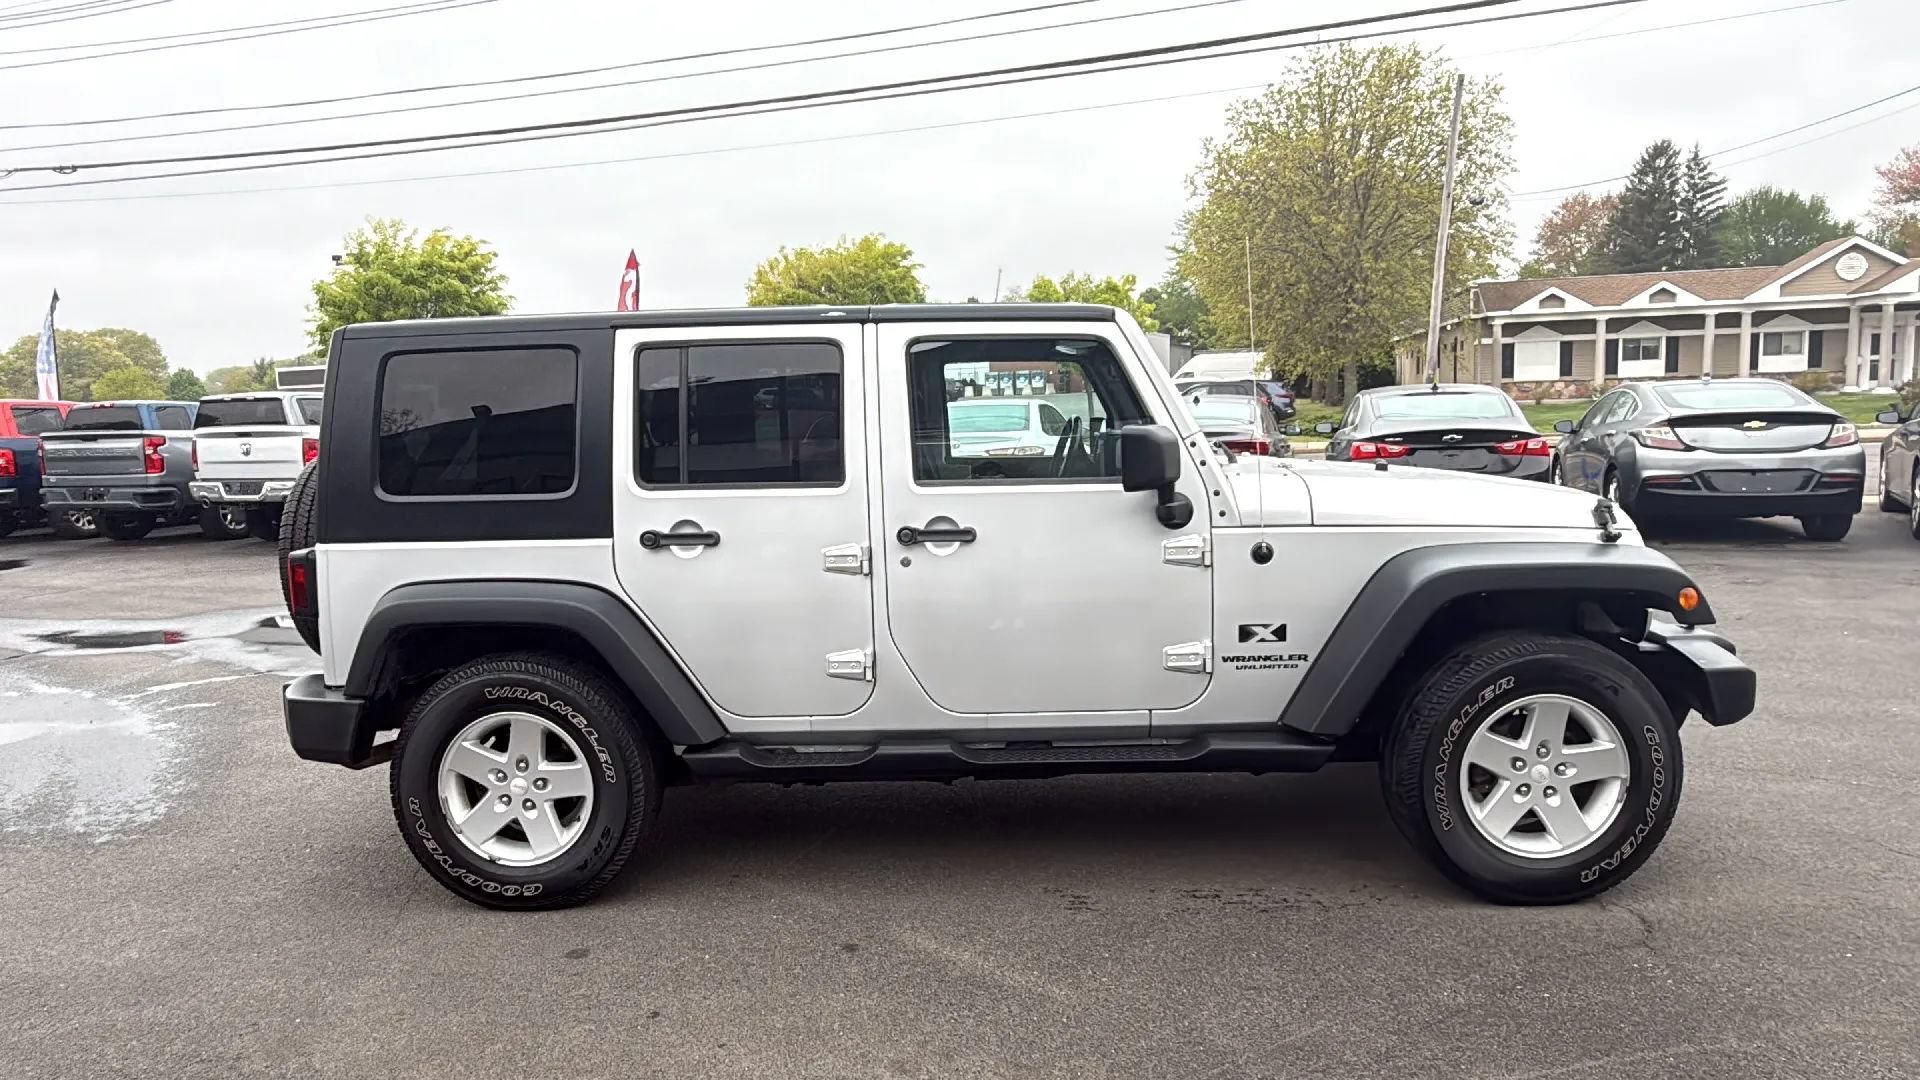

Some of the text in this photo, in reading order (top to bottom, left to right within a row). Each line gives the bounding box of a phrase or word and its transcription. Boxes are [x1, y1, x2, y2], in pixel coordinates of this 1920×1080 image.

[1221, 654, 1309, 663] WRANGLER
[1235, 663, 1299, 671] UNLIMITED
[1243, 623, 1285, 643] X
[484, 686, 617, 784] WRANGLER
[1433, 676, 1515, 831] WRANGLER
[408, 797, 543, 897] GOODYEAR
[1580, 725, 1665, 883] GOODYEAR
